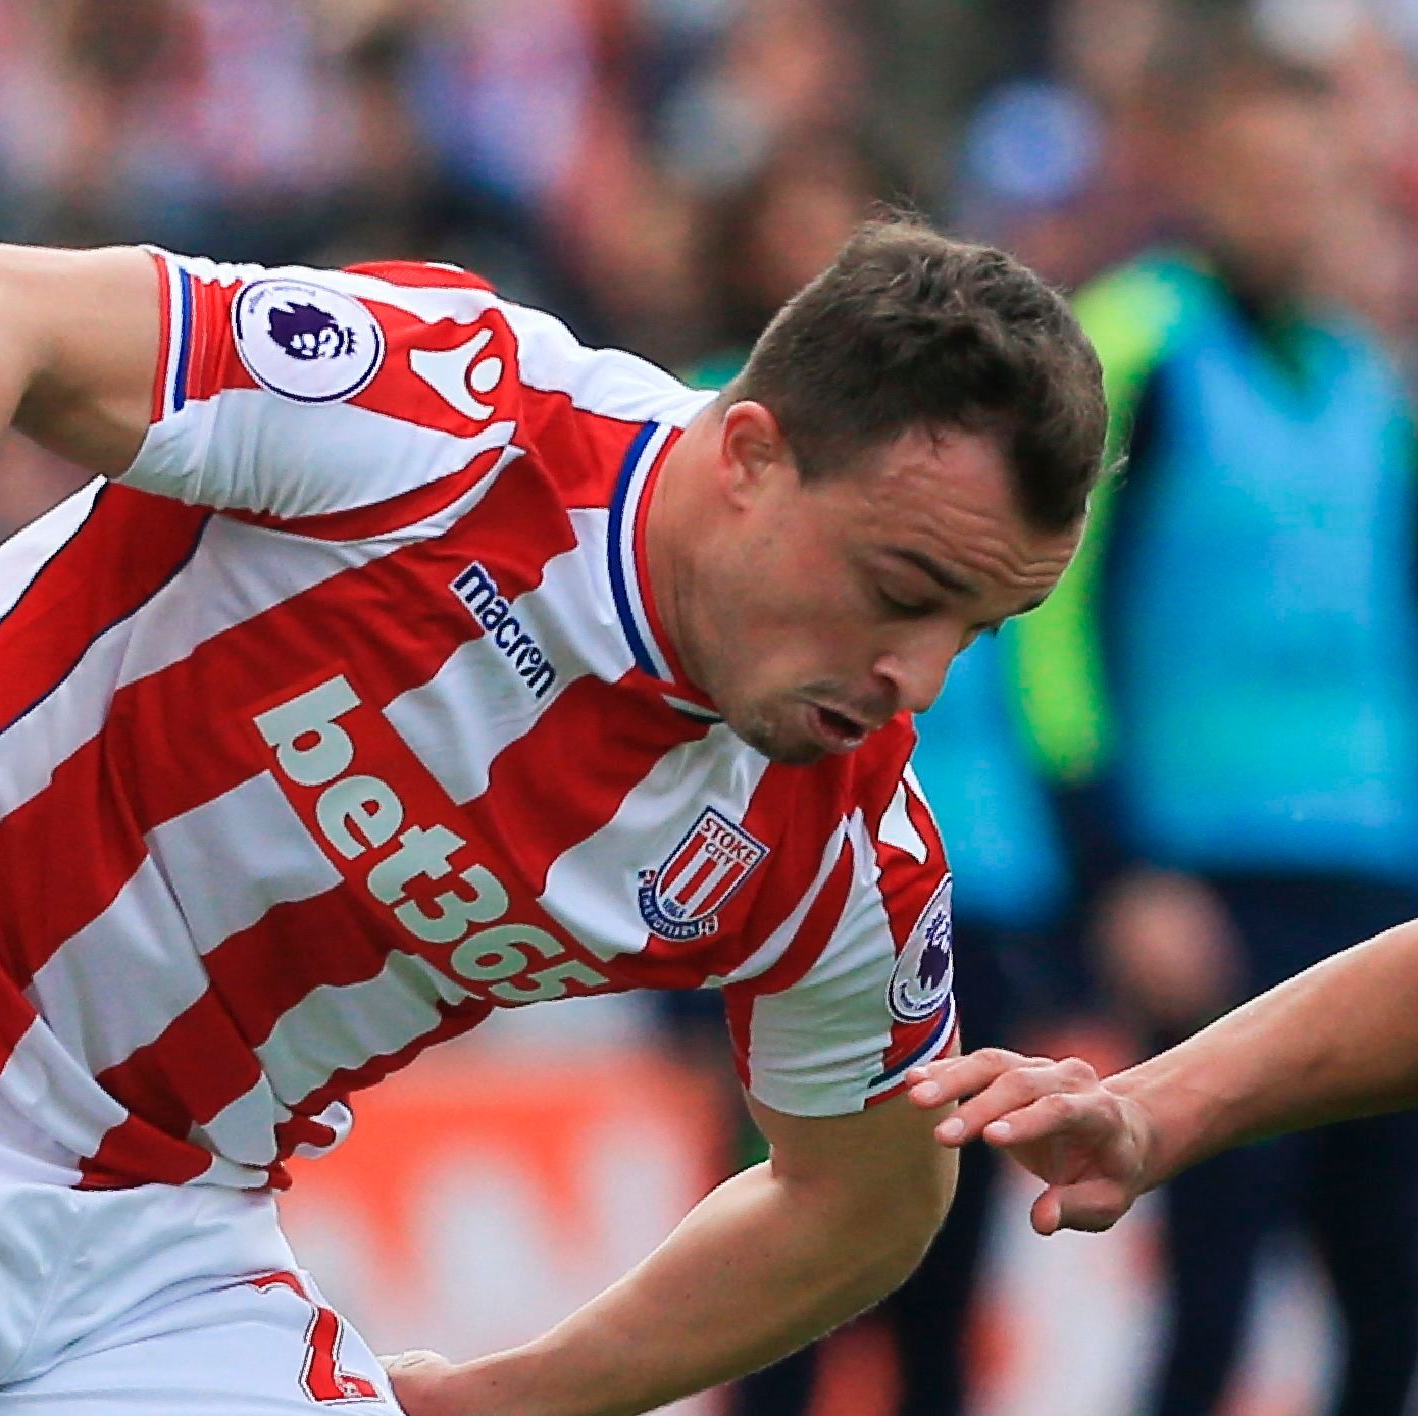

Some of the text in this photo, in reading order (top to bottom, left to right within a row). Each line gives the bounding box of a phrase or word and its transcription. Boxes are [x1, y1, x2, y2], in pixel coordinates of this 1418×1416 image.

[453, 564, 556, 698] macron
[253, 674, 610, 1001] bet365
[701, 817, 758, 865] STOKE
[705, 842, 735, 866] CITY
